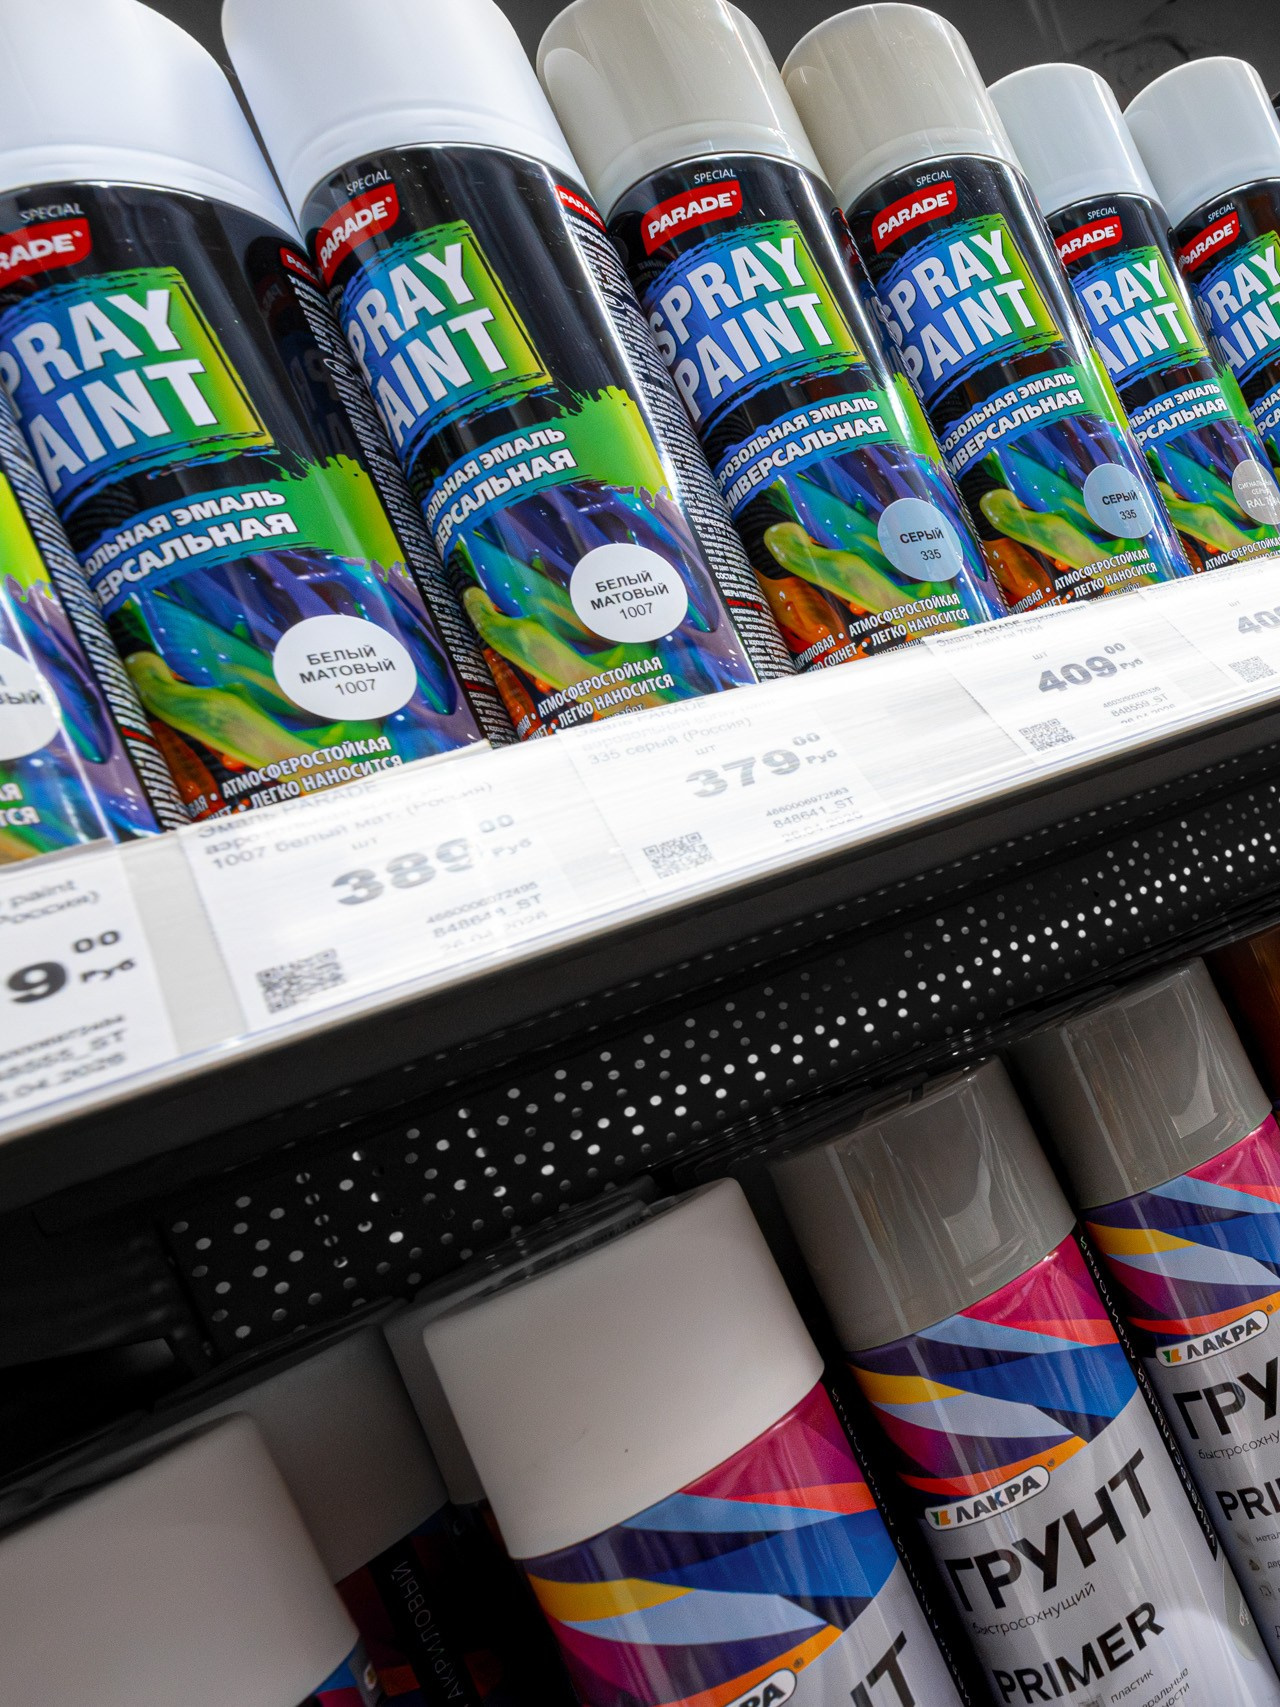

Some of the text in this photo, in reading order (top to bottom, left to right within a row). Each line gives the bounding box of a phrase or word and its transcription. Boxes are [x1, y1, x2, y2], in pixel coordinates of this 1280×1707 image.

[346, 168, 391, 197] SPECIAL
[693, 168, 737, 184] SPECIAL
[916, 169, 952, 186] SPECIAL
[21, 203, 84, 223] SPECIAL
[647, 195, 730, 239] PARADE
[877, 191, 947, 239] PARADE
[1087, 207, 1117, 220] SPECIAL
[1207, 202, 1235, 222] SPECIAL
[320, 198, 387, 266] PARADE
[646, 237, 804, 362] SPRAY
[909, 280, 1038, 393] PAINT
[674, 293, 835, 421] PAINT
[1019, 371, 1075, 398] ЭМАЛЬ
[1175, 381, 1221, 404] ЭМАЛЬ
[28, 359, 219, 492] AINT
[809, 396, 878, 424] ЭМАЛЬ
[482, 429, 567, 468] ЭМАЛЬ
[174, 490, 286, 527] ЭМАЛЬ
[1101, 491, 1138, 507] СЕРЫЙ
[1120, 509, 1136, 521] 335
[900, 529, 944, 544] СЕРЫЙ
[920, 548, 941, 561] 335
[595, 570, 653, 593] БЕЛЫЙ
[1055, 548, 1150, 591] АТМОСФЕРОСТОЙКАЯ
[1074, 561, 1161, 597] ЛЕГКО НАНОСИТСЯ
[590, 583, 669, 610] МАТОВЫЙ
[618, 602, 653, 621] 1007
[849, 593, 961, 638] АТМОСФЕРОСТОЙКАЯ
[871, 608, 970, 647] ЛЕГКО НАНОСИТСЯ
[299, 657, 397, 684] МАТОВЫЙ
[306, 643, 378, 667] БЕЛЫЙ
[1039, 643, 1126, 692] 409 00
[334, 677, 376, 698] 1007
[537, 657, 663, 718] АТМОСФЕРОСТОЙКАЯ
[558, 701, 594, 727] ЛЕГКО
[595, 674, 674, 714] НАНОСИТСЯ
[220, 736, 392, 799] АТМОСФЕРОСТОЙКАЯ
[249, 776, 302, 813] ЛЕГКО
[300, 755, 403, 791] НАНОСИТСЯ
[686, 749, 800, 798] 379
[331, 837, 470, 905] 389
[73, 930, 120, 953] 00
[80, 959, 136, 984] Руб
[1187, 1318, 1262, 1360] ЛАКРА
[955, 1475, 1042, 1524] ЛАКРА
[944, 1448, 1152, 1612] ГРУНТ
[971, 1583, 1095, 1636] быстросохнущий
[992, 1602, 1165, 1704] PRIMER
[1110, 1669, 1154, 1703] пластик
